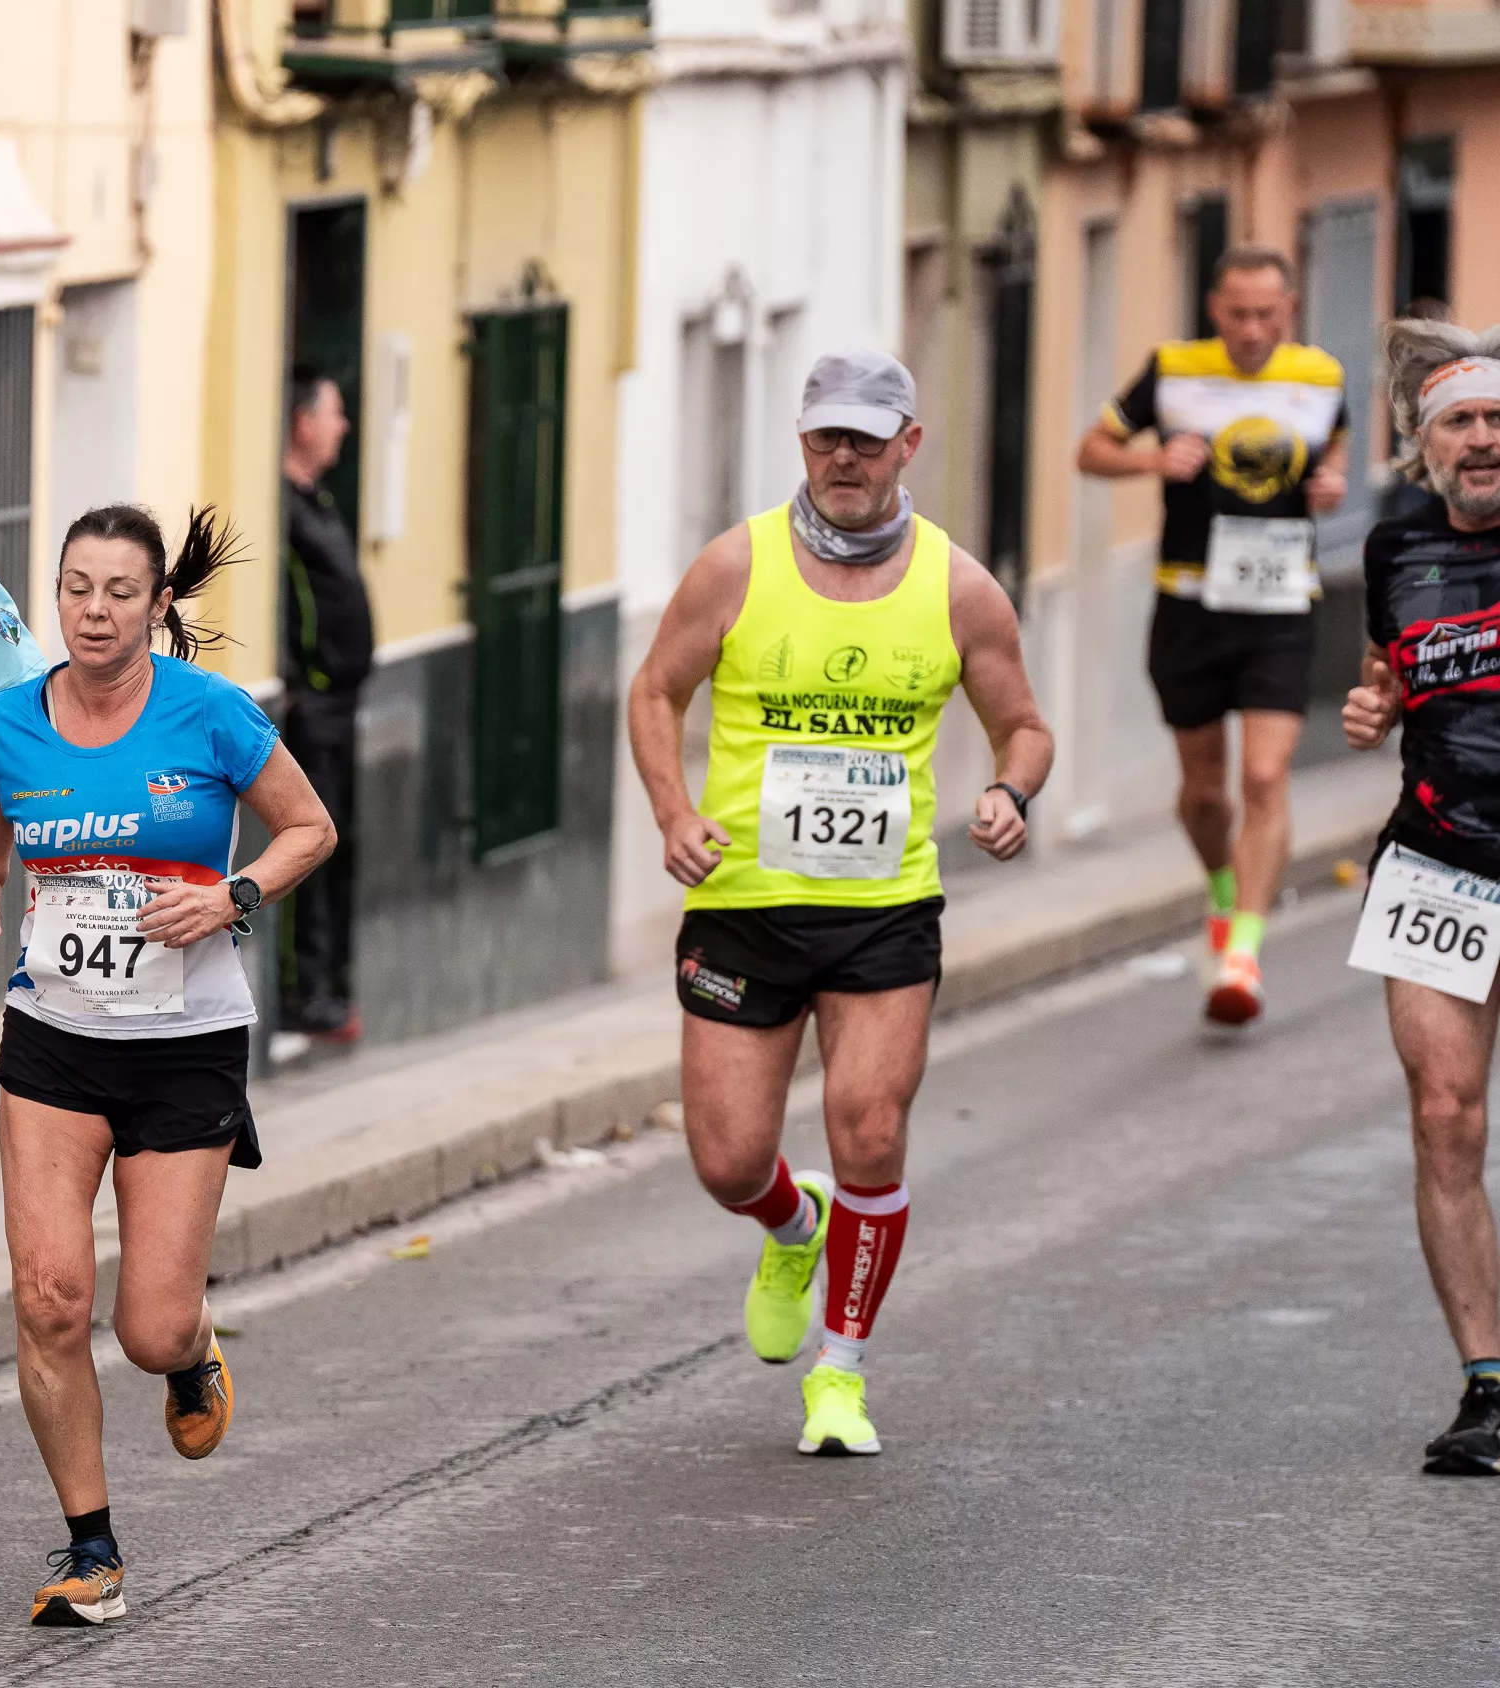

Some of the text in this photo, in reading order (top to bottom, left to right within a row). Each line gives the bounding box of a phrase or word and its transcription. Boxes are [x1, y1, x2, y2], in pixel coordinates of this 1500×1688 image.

[792, 693, 859, 709] NOCTURNA
[862, 695, 878, 711] DE
[760, 706, 916, 736] EL SANTO
[150, 794, 177, 805] Club
[152, 799, 194, 813] Maratón
[154, 810, 193, 823] Lucena
[784, 803, 889, 845] 1321
[13, 811, 140, 849] nerplus
[63, 838, 136, 852] directo
[88, 914, 111, 922] CIUDAD
[1387, 902, 1488, 962] 1506
[58, 932, 149, 979] 947
[68, 986, 93, 996] ARACELI
[93, 989, 120, 997] AMARO
